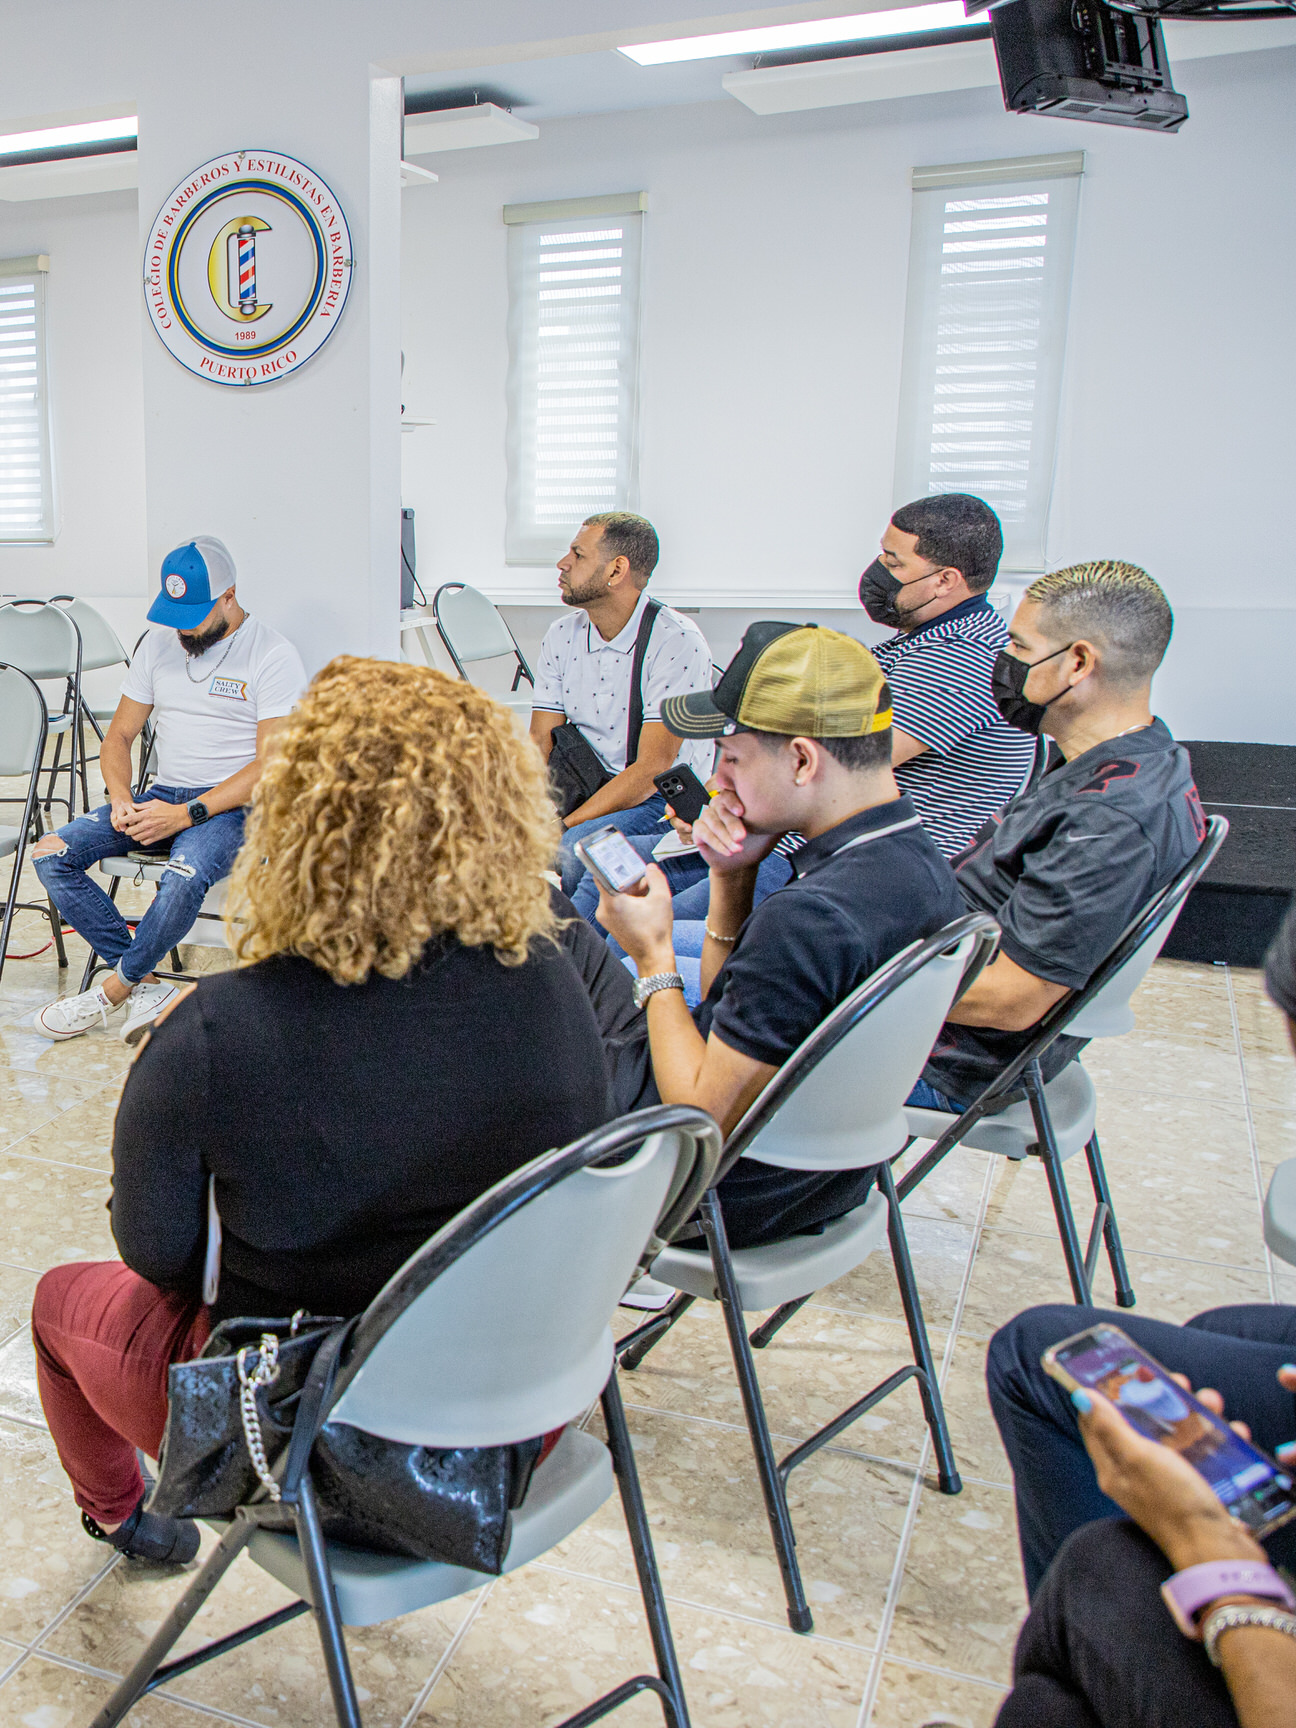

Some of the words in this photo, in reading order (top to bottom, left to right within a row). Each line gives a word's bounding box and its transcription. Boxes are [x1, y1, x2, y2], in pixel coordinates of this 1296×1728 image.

[233, 160, 243, 172] Y
[163, 163, 230, 226] BARBEROS
[248, 159, 325, 206] ESTILISTAS
[320, 204, 338, 228] EN
[154, 228, 168, 251] DE
[320, 231, 344, 318] BARBERIA
[151, 255, 172, 330] COLEGIO
[235, 331, 256, 341] 1989
[199, 356, 258, 379] PUERTO
[261, 350, 297, 376] RICO
[214, 686, 239, 695] CREW
[215, 680, 241, 689] SALTY
